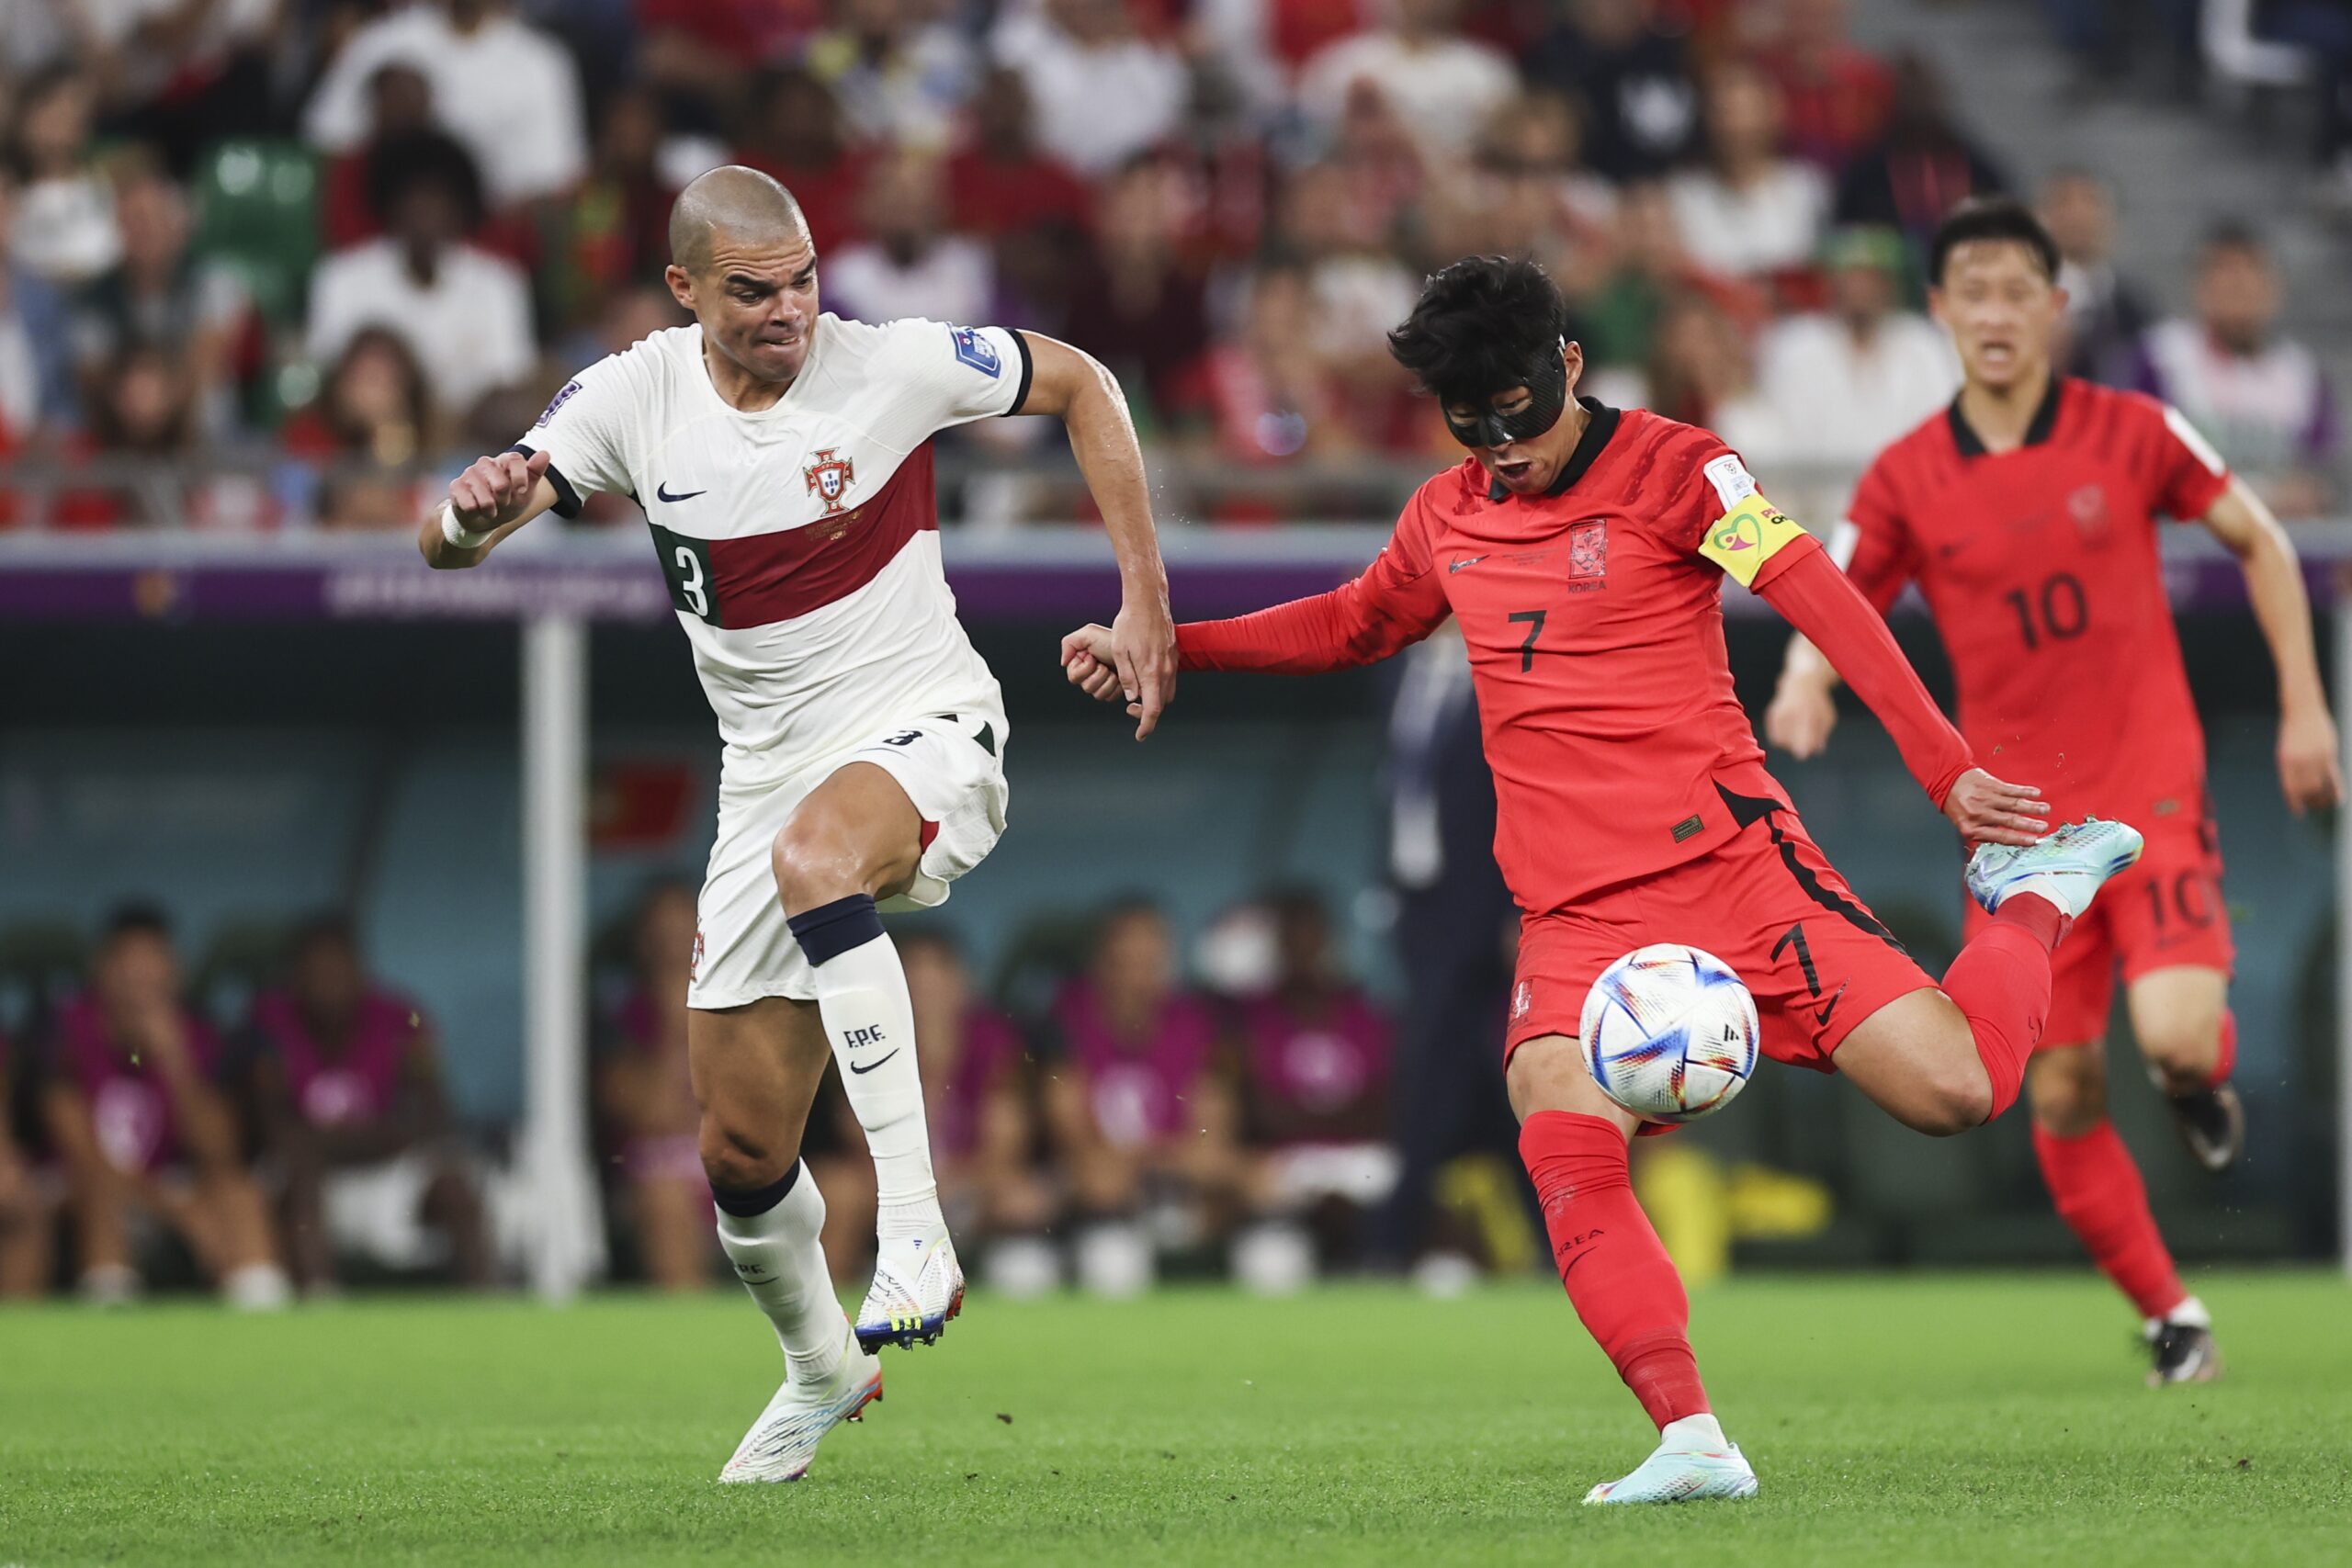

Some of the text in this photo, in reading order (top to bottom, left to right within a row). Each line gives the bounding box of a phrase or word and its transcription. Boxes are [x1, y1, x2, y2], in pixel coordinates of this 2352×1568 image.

[675, 546, 708, 616] 3
[1568, 580, 1606, 593] KOREA
[2007, 571, 2088, 649] 10
[1508, 610, 1547, 673] 7
[882, 730, 923, 746] 3
[2143, 867, 2219, 930] 10
[1770, 921, 1822, 999] 7
